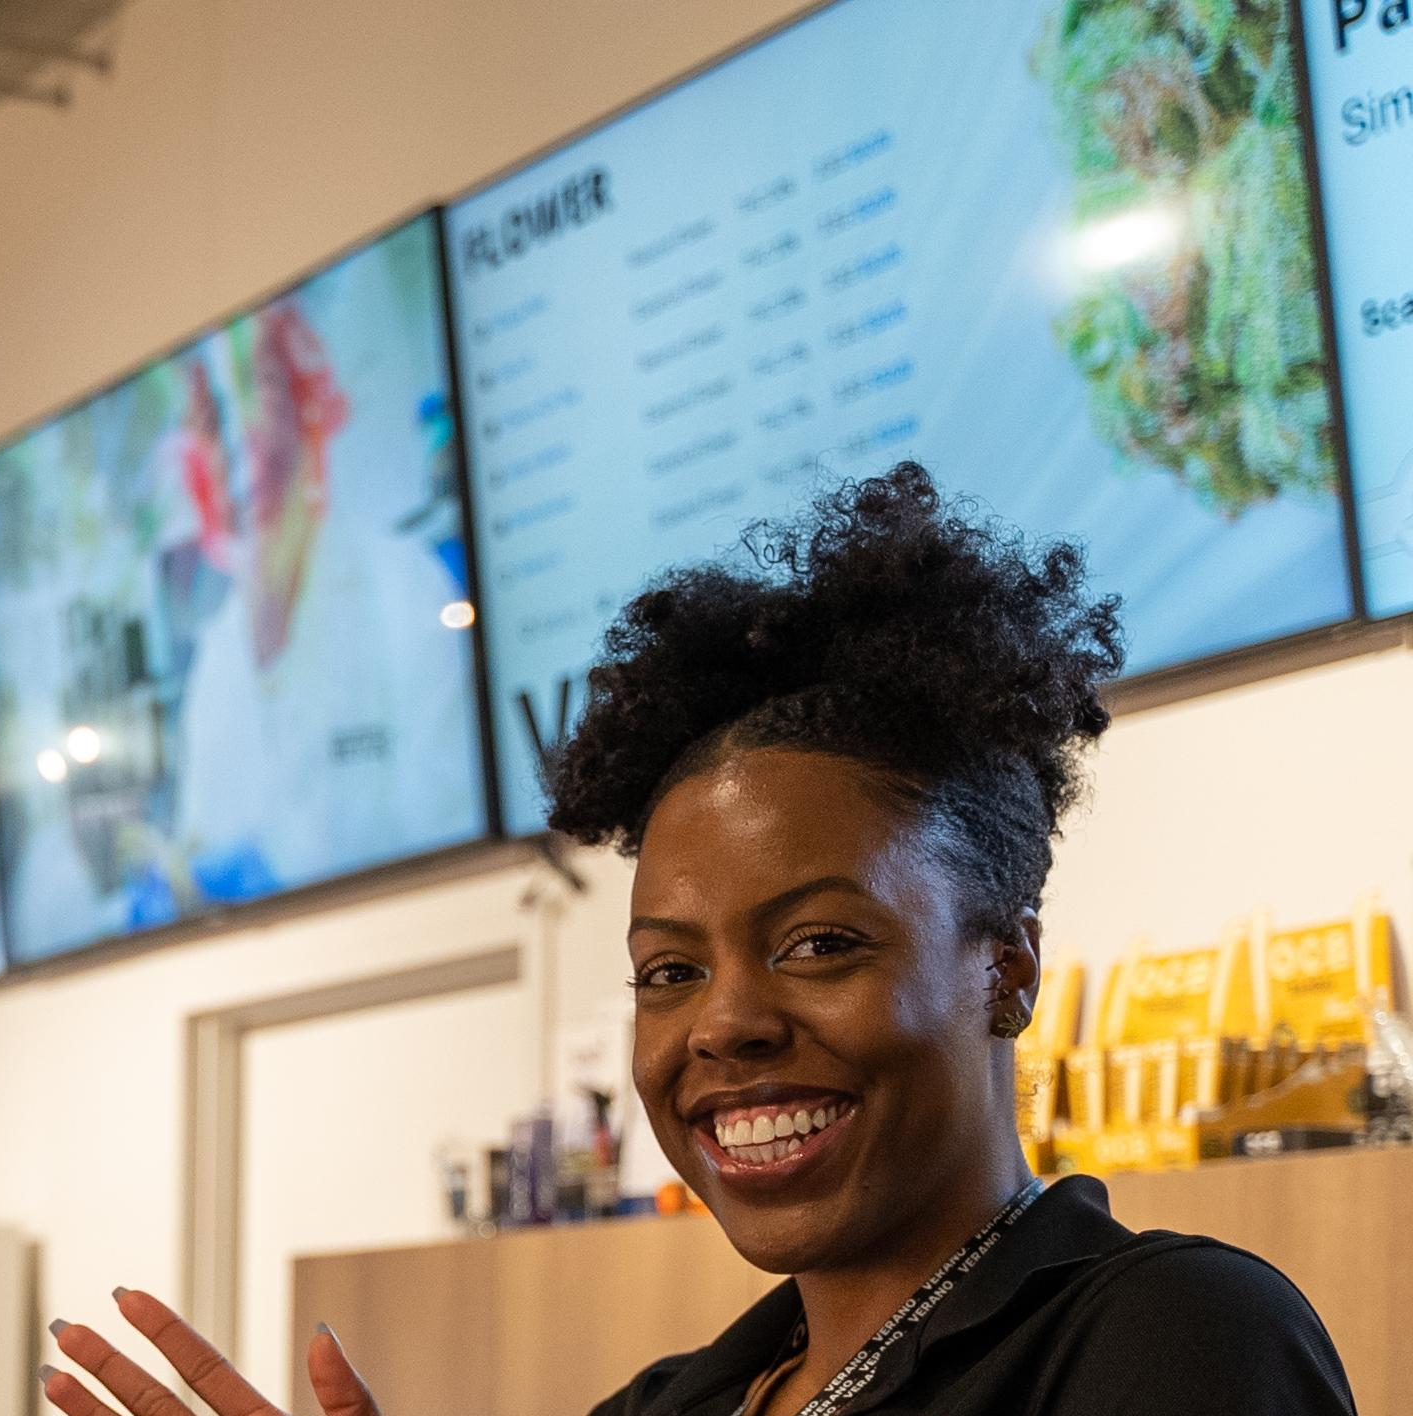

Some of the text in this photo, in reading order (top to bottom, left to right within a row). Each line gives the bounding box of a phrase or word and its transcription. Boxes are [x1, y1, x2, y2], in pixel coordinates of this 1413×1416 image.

[958, 1232, 1002, 1273] VERANO
[873, 1298, 916, 1342] VERANO
[908, 1280, 953, 1322] VERANO
[824, 1350, 868, 1392] VERANO
